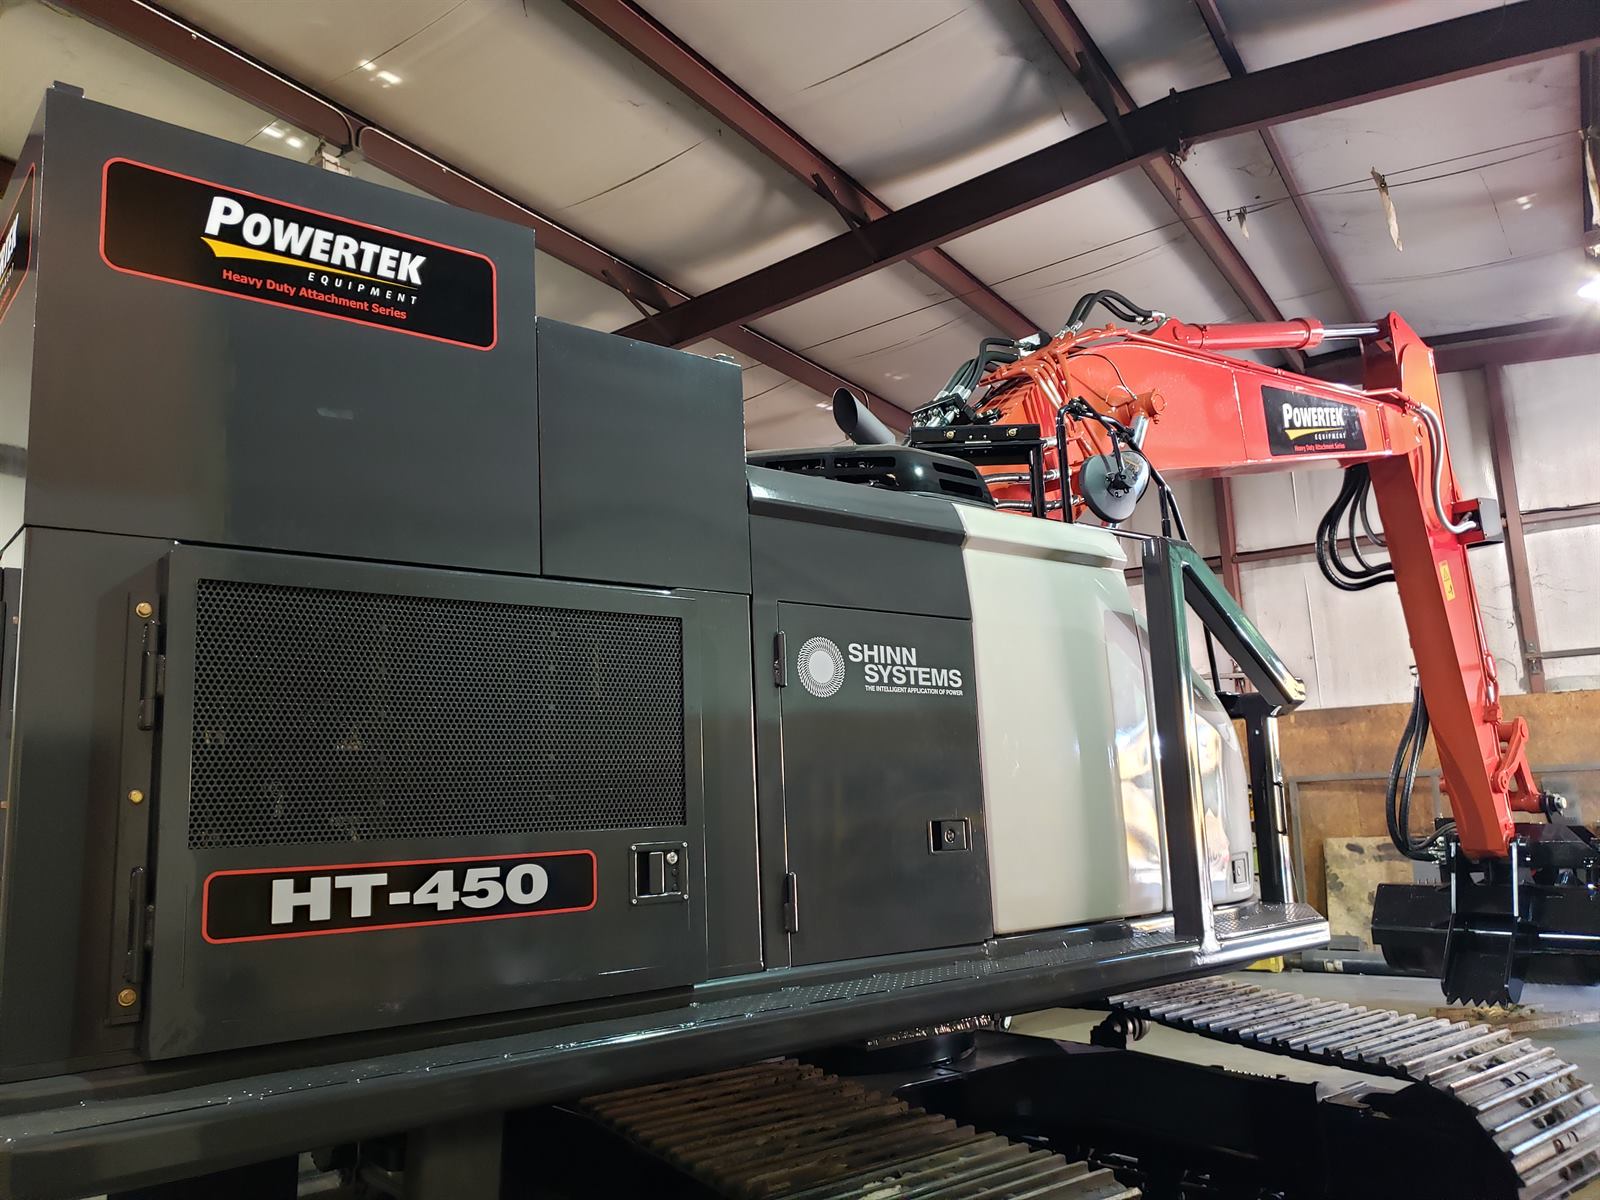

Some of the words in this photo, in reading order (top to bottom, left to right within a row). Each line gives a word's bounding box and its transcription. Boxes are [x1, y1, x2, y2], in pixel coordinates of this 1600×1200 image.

[204, 196, 427, 285] POWERTEK
[222, 269, 264, 289] Heavy
[266, 279, 297, 296] Duty
[298, 287, 369, 312] Attachment
[371, 303, 407, 320] Series
[308, 272, 417, 305] EQUIPMENT
[1282, 403, 1345, 428] POWERTEK
[848, 643, 917, 666] SHINN
[864, 663, 963, 688] SYSTEMS
[907, 687, 939, 695] APPLICATION
[271, 863, 549, 925] HT-450
